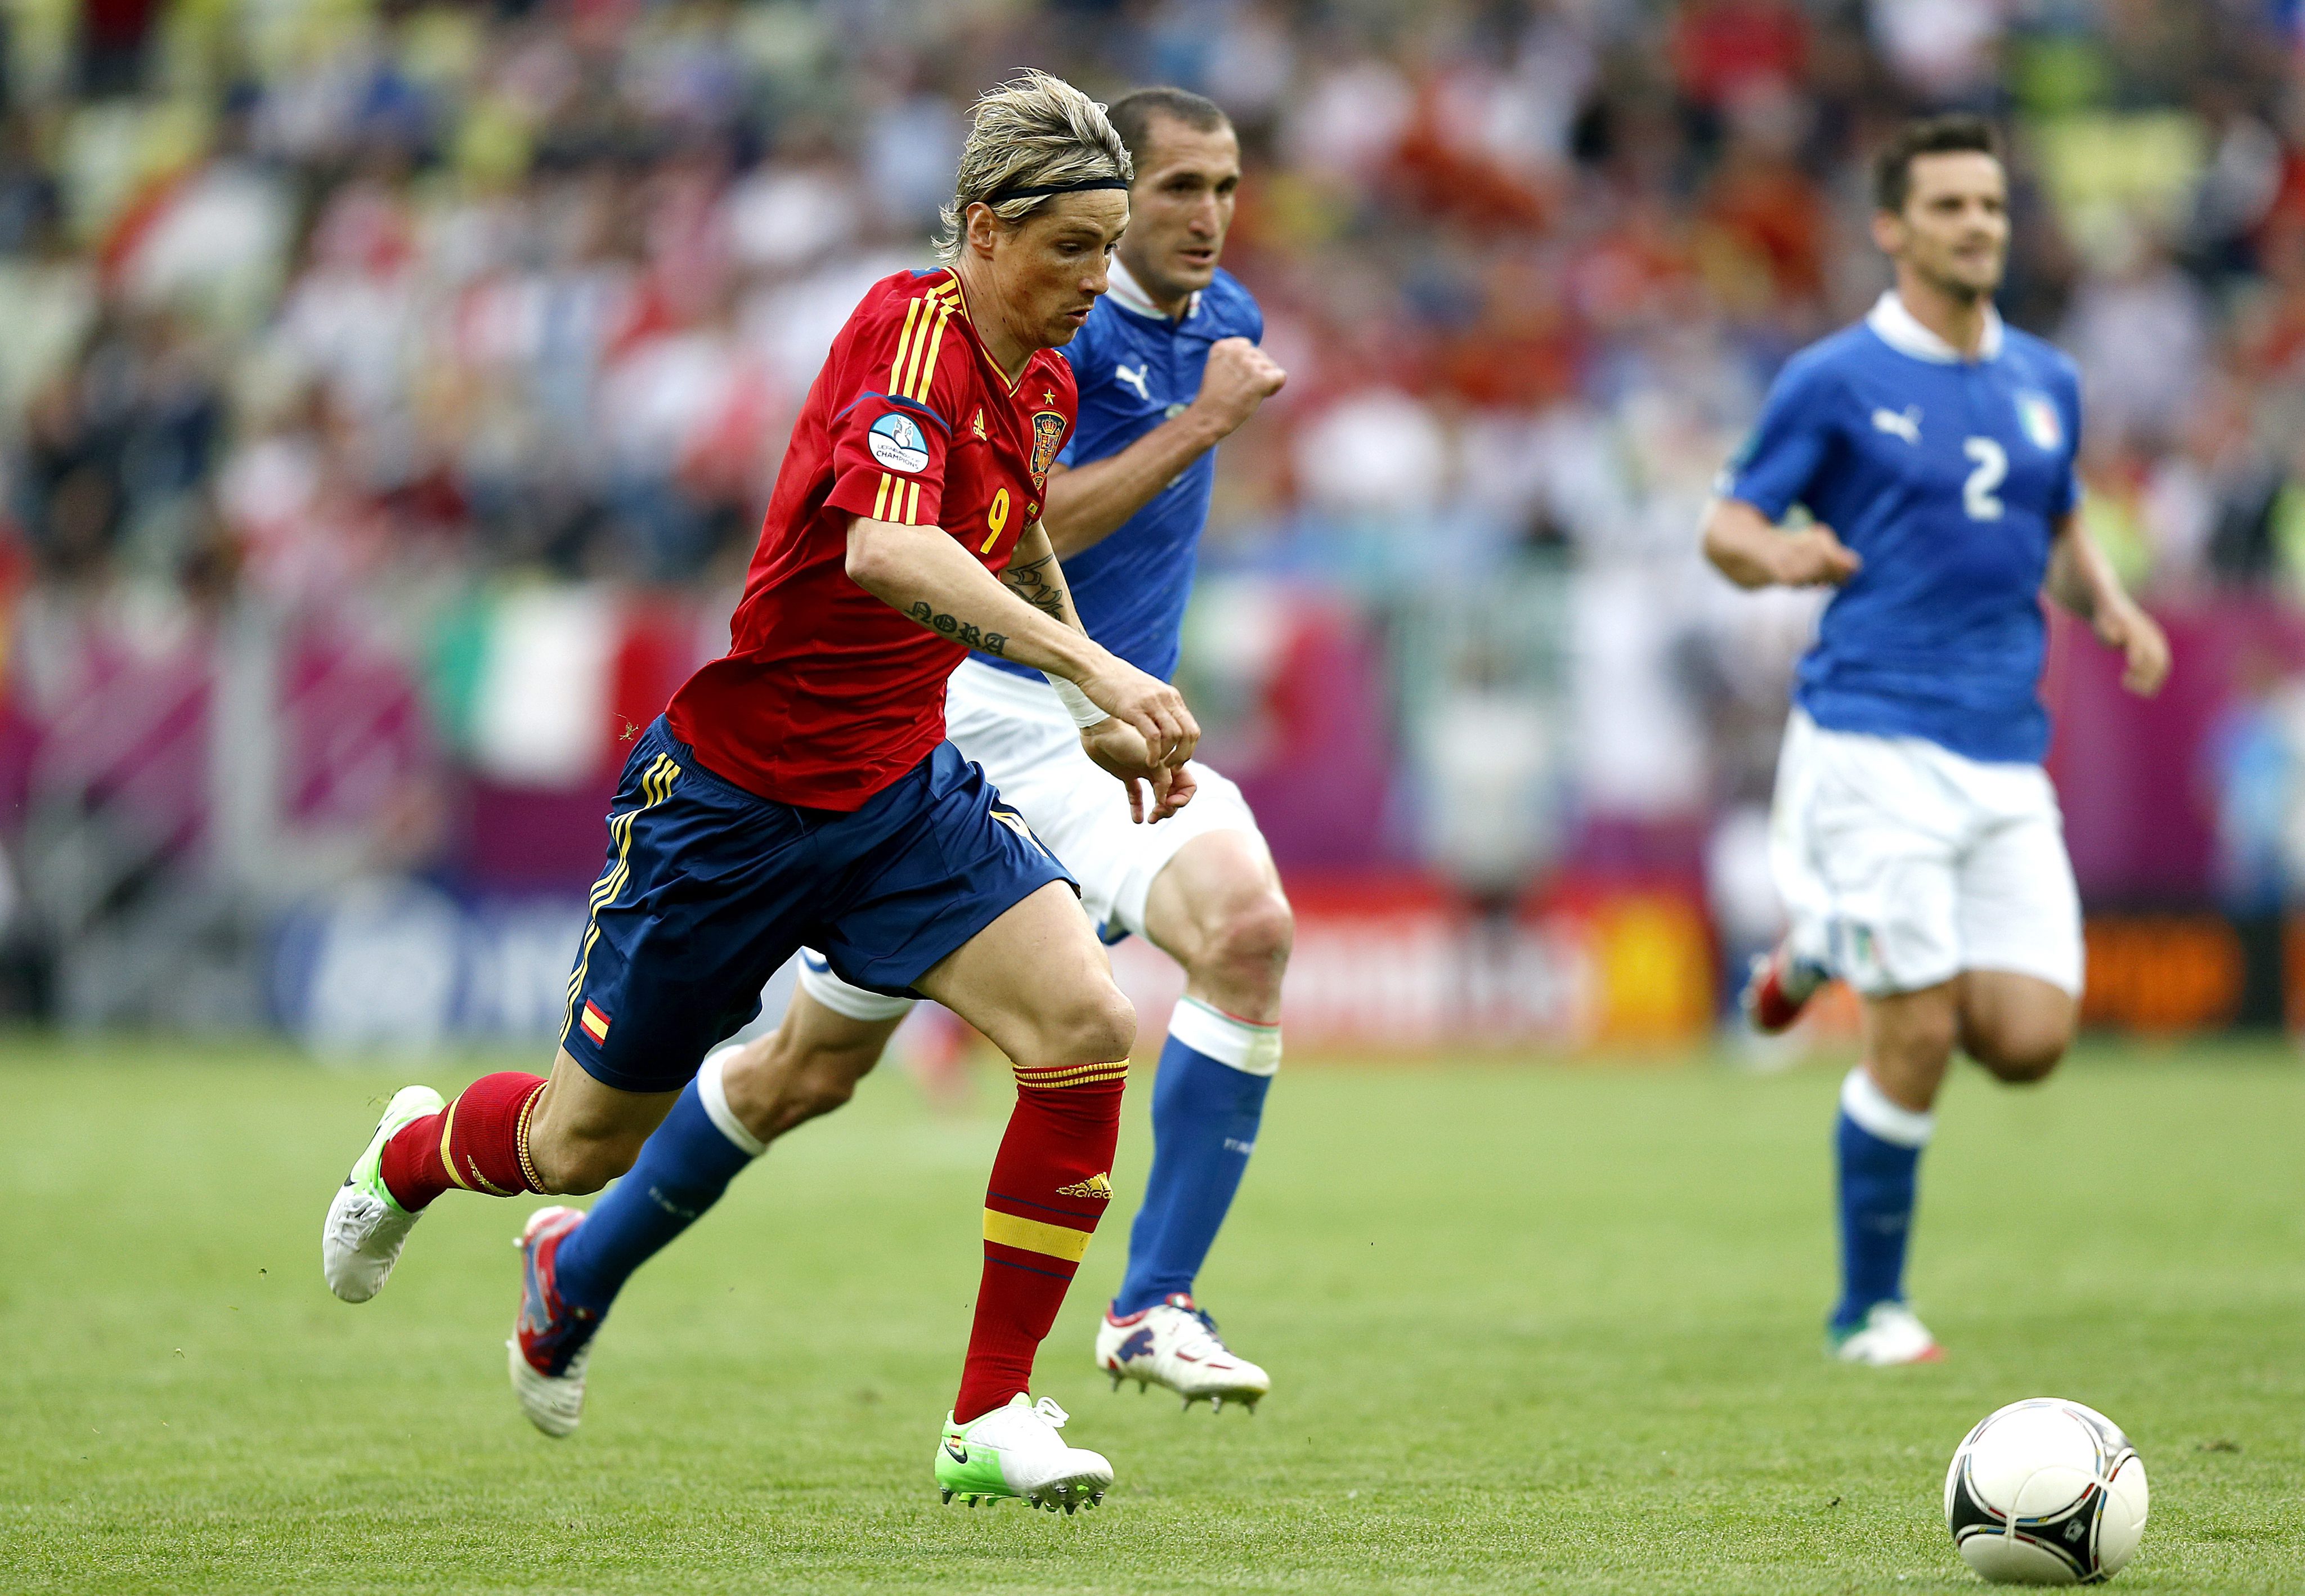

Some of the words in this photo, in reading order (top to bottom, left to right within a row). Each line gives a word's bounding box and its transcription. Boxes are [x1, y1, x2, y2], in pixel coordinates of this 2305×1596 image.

[876, 450, 918, 469] CHAMPIONS
[1962, 436, 2010, 522] 2
[980, 488, 1010, 554] 9
